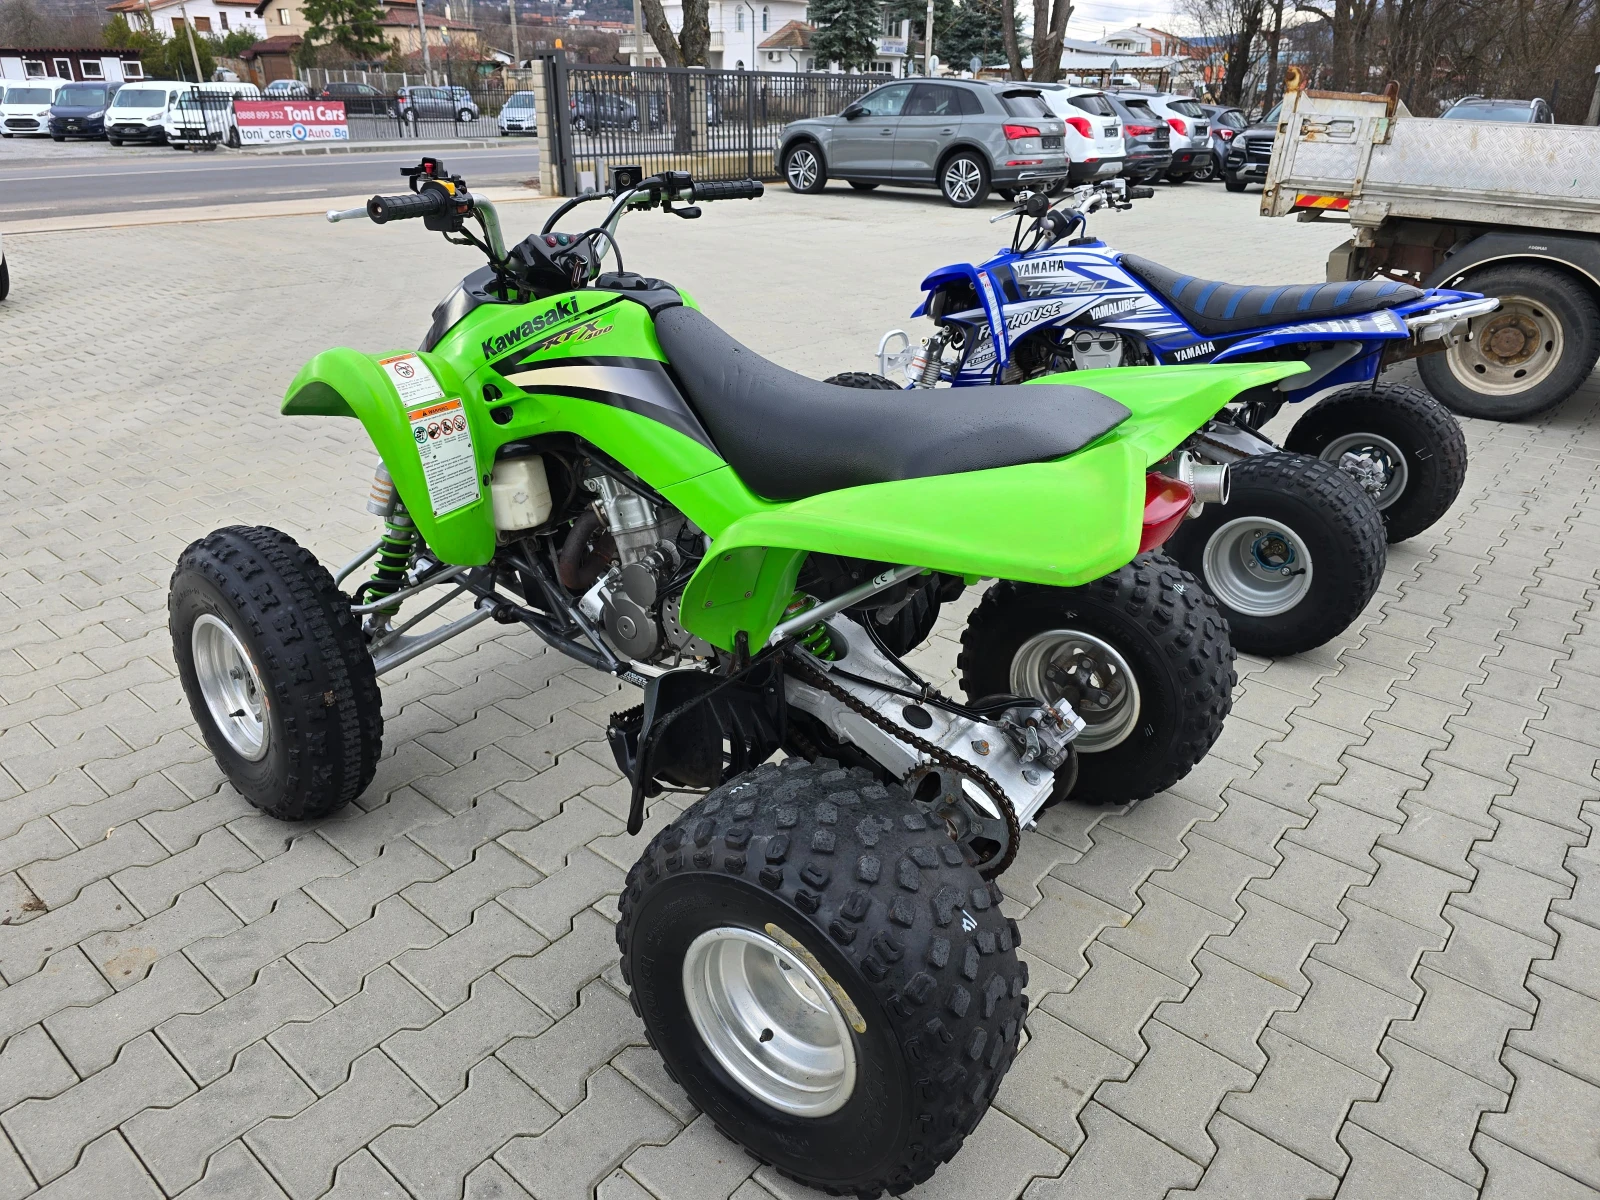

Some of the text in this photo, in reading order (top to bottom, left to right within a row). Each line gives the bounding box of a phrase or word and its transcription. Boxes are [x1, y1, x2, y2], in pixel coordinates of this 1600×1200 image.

[237, 111, 284, 119] 0888 899 352
[284, 106, 345, 121] Toni Cars
[1017, 260, 1065, 275] YAMAHA
[1089, 297, 1136, 320] YAMALUBE
[481, 295, 579, 360] Kawasaki
[584, 324, 614, 341] 400
[1174, 341, 1216, 362] YAMAHA
